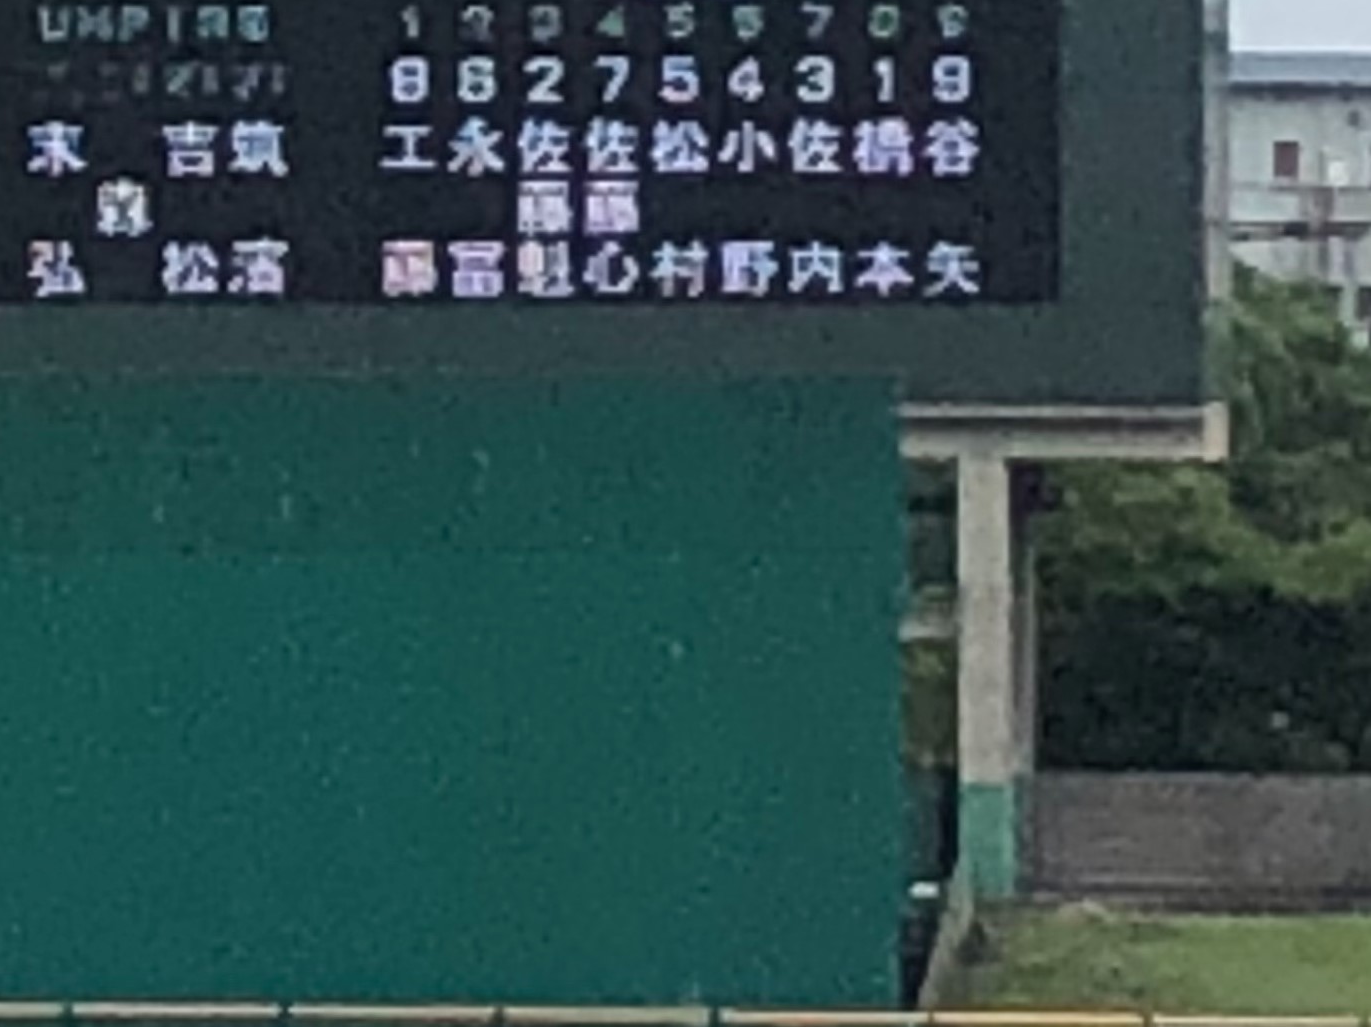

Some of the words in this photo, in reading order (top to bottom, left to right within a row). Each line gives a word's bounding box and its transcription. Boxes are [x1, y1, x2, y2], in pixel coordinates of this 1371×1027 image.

[401, 6, 420, 38] 1
[665, 1, 695, 39] 5
[801, 2, 833, 37] 7
[390, 56, 429, 103] 8
[457, 56, 496, 103] 6
[524, 56, 564, 103] 2
[595, 55, 630, 102] 7
[659, 55, 699, 103] 5
[727, 57, 764, 102] 4
[795, 55, 835, 103] 3
[874, 58, 894, 102] 1
[932, 55, 970, 103] 9
